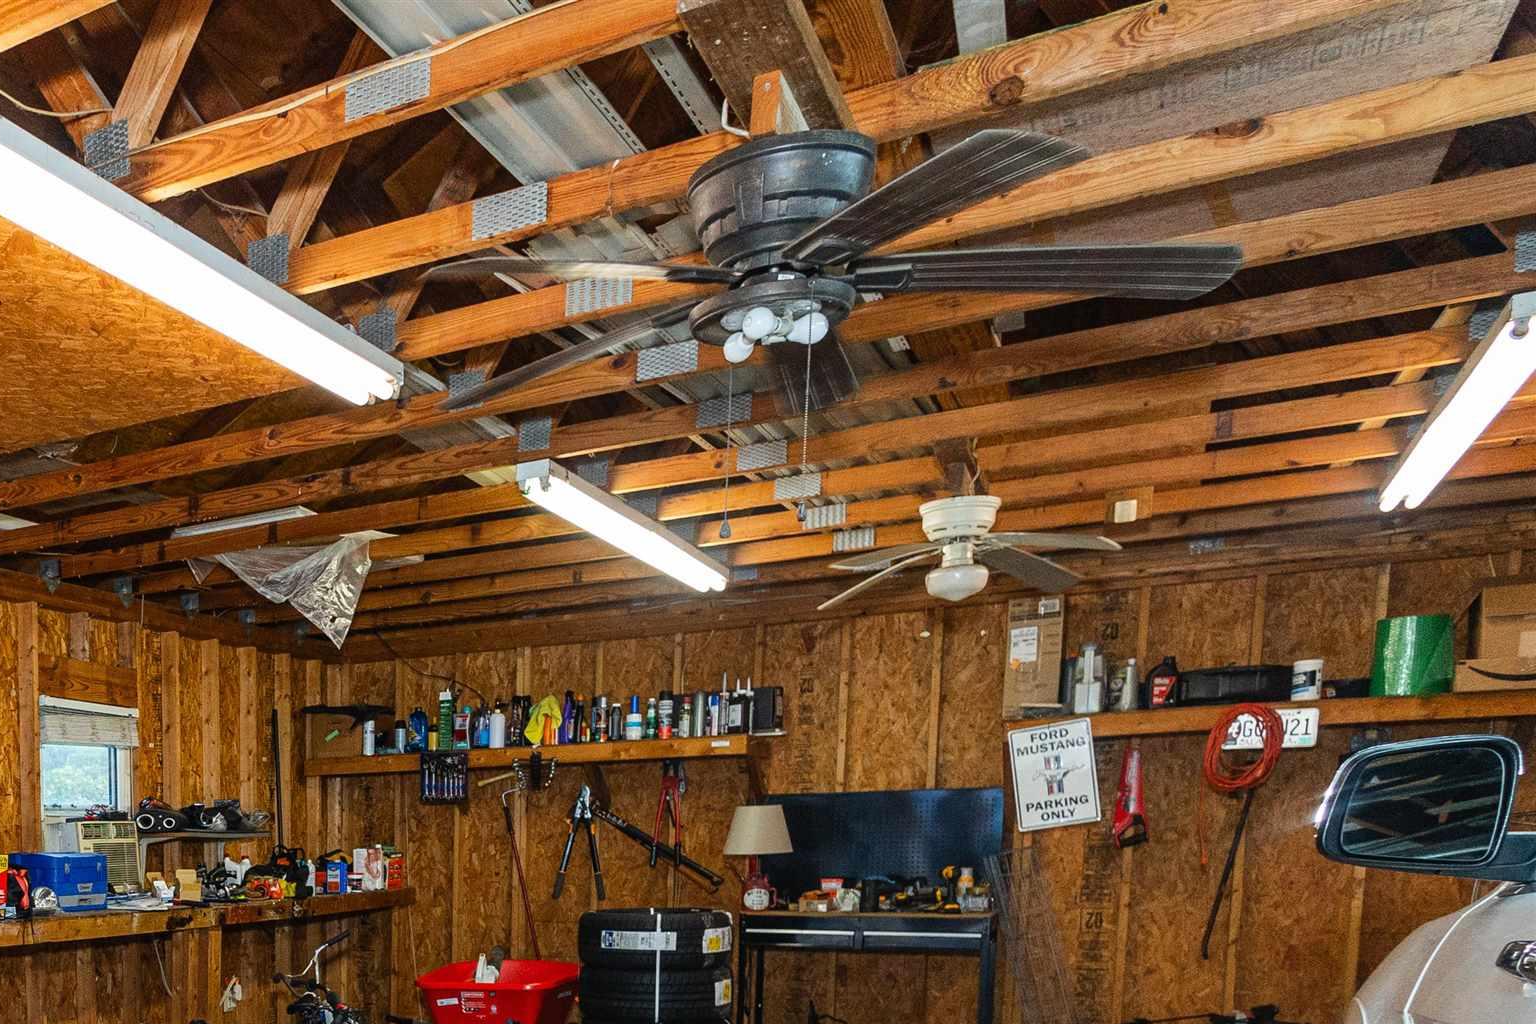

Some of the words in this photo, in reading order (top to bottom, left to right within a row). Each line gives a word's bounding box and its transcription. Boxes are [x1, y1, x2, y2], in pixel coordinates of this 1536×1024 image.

[1030, 727, 1069, 743] FORD
[1016, 736, 1086, 757] MUSTANG
[1026, 794, 1089, 813] PARKING
[1040, 808, 1076, 822] ONLY
